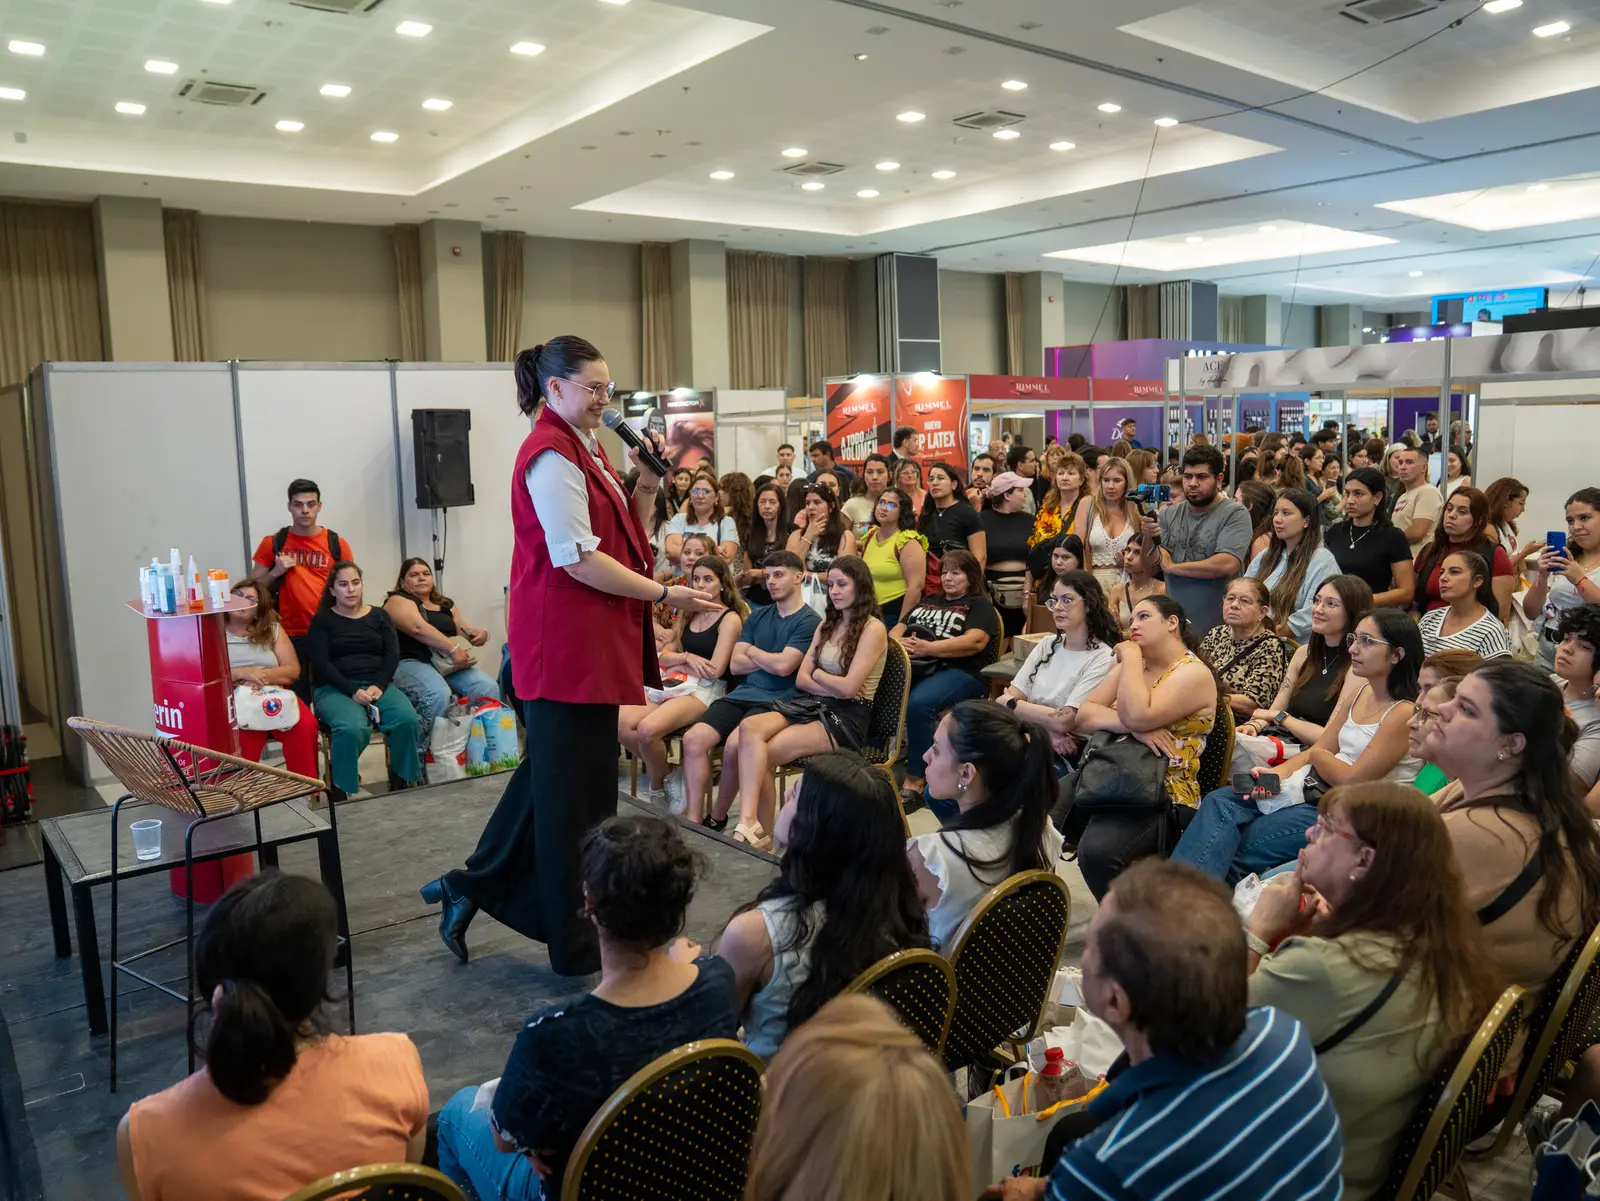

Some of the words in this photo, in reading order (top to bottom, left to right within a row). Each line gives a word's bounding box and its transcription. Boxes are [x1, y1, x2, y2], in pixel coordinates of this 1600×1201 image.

[1016, 383, 1049, 392] RIMMEL
[1133, 386, 1164, 394] RIMMEL
[843, 403, 875, 414] RIMMEL
[914, 401, 950, 411] RIMMEL
[841, 436, 846, 448] A
[847, 431, 864, 445] TODO
[928, 431, 955, 449] LATEX
[841, 439, 878, 461] VOLUMEN
